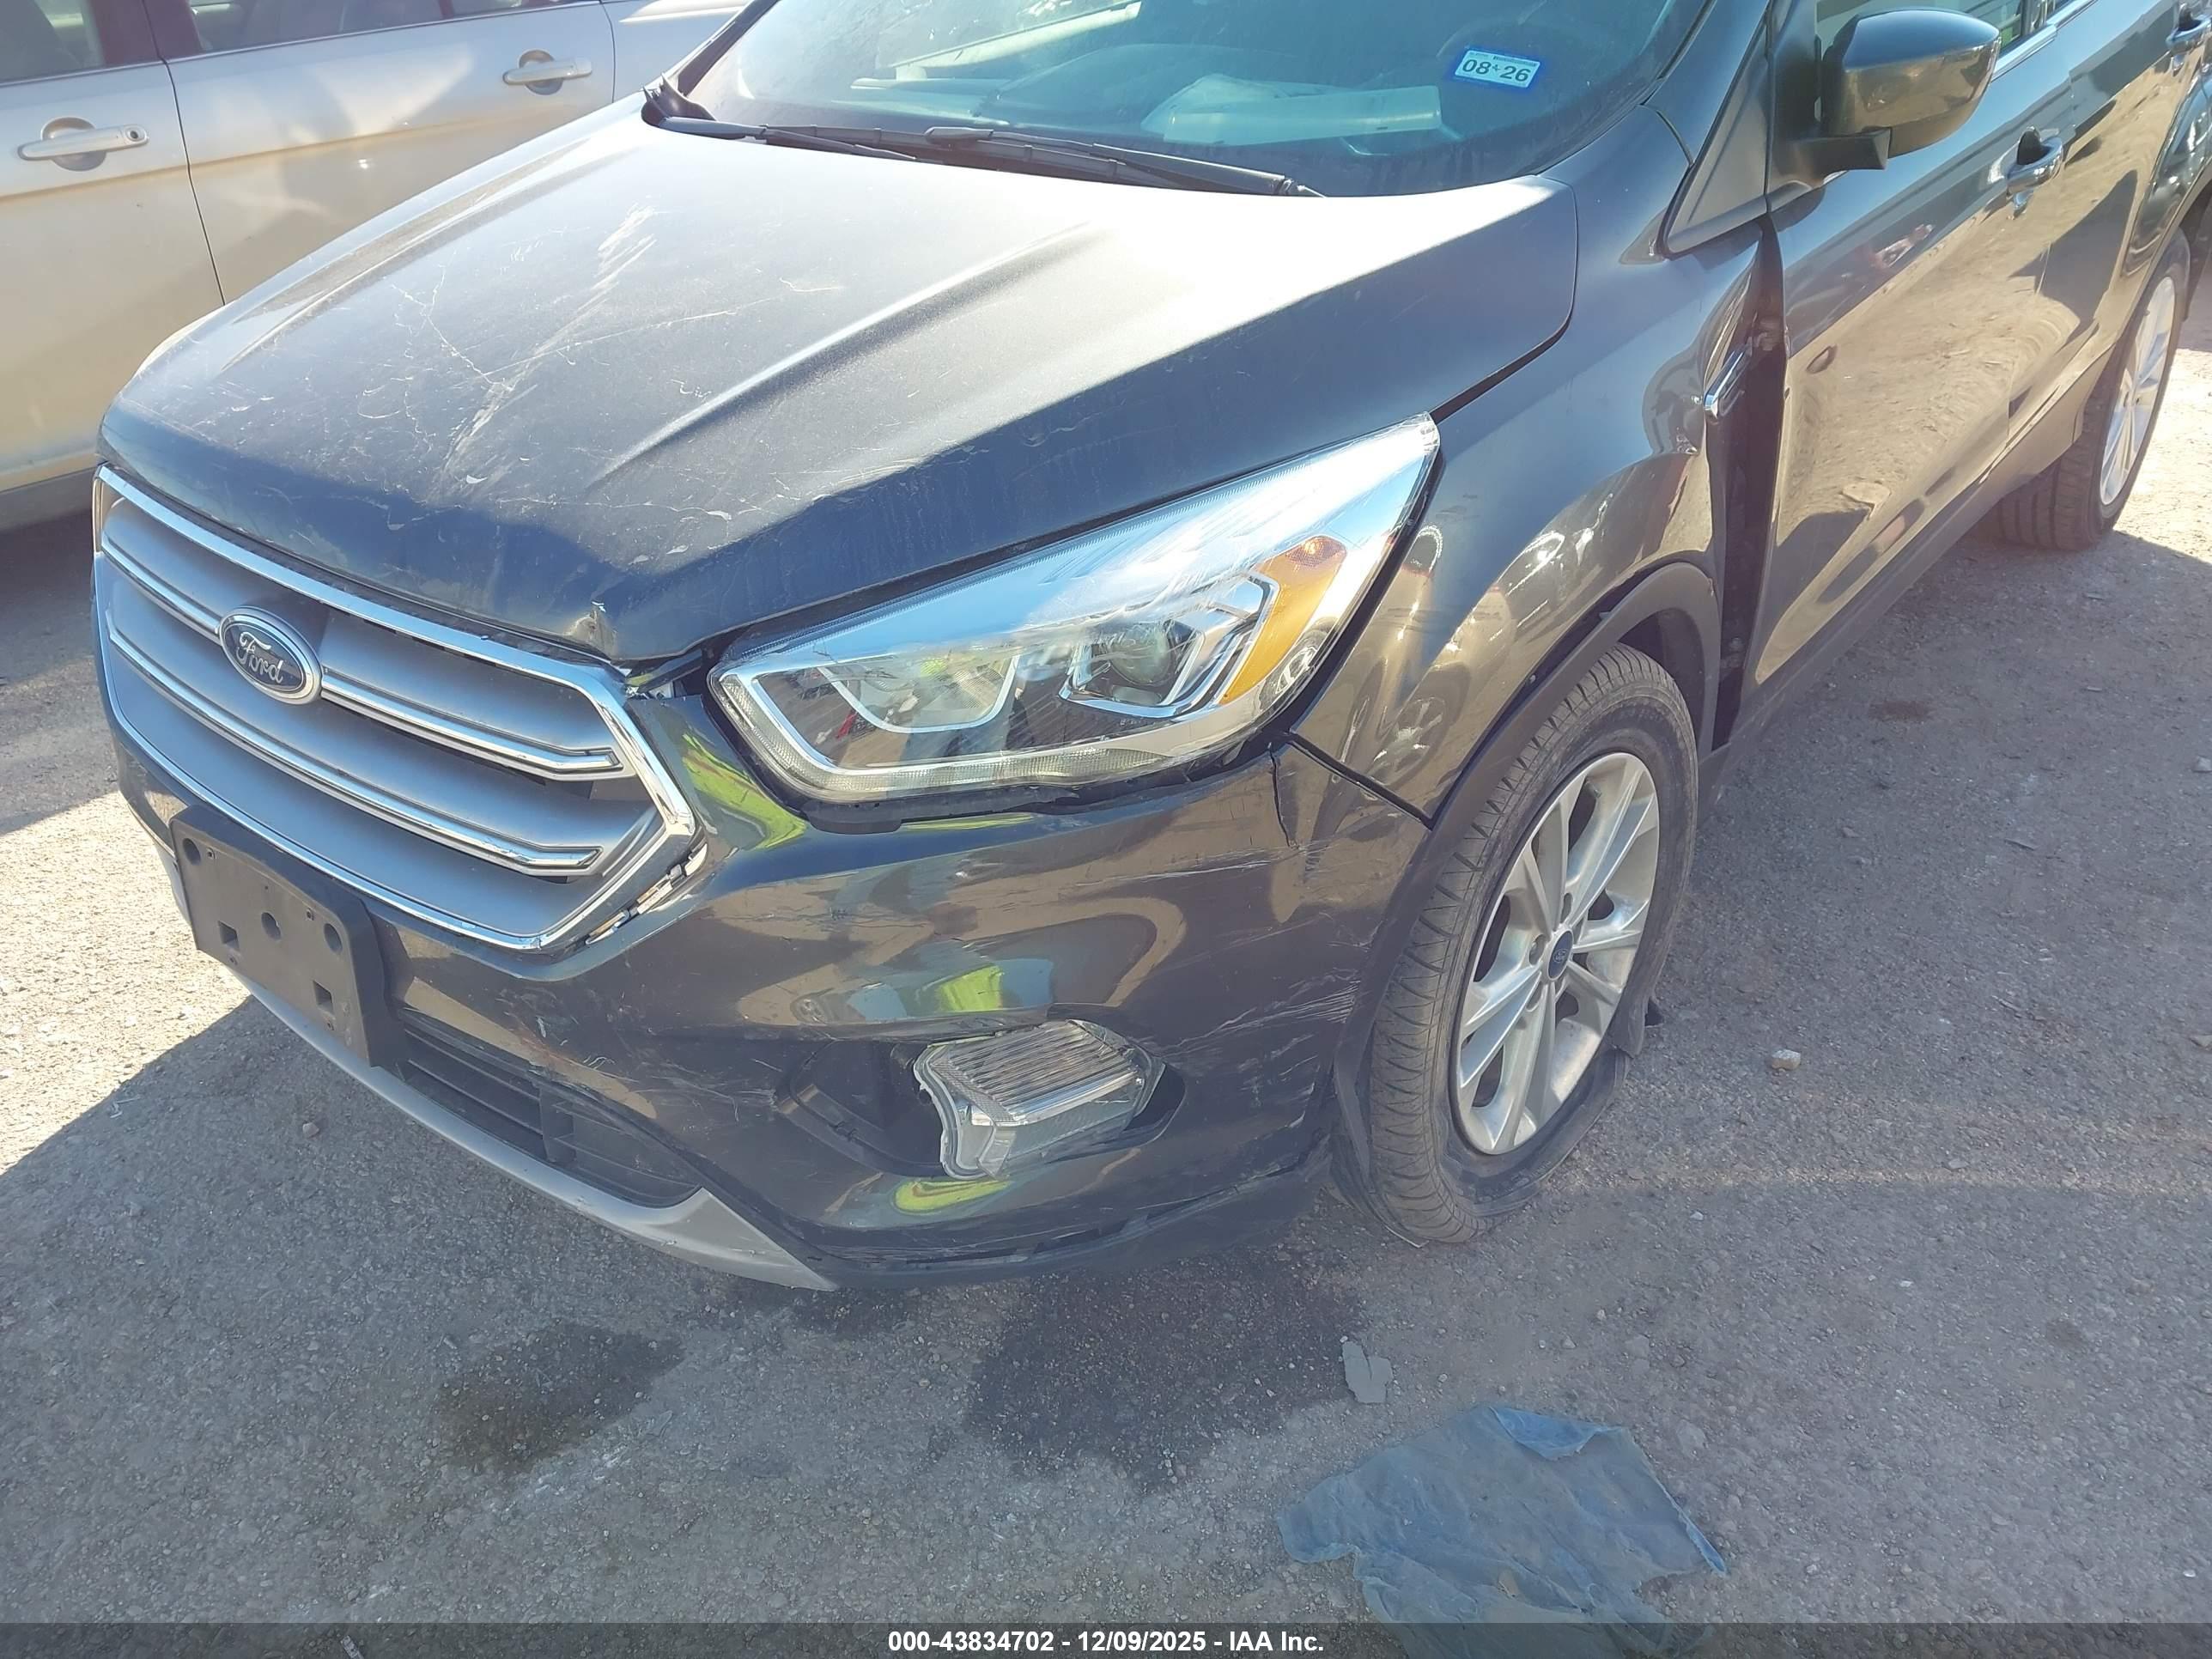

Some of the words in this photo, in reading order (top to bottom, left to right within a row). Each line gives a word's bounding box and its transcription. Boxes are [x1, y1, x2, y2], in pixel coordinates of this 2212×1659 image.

[1462, 58, 1492, 76] 08
[1499, 65, 1532, 82] 26
[236, 631, 284, 684] Ford
